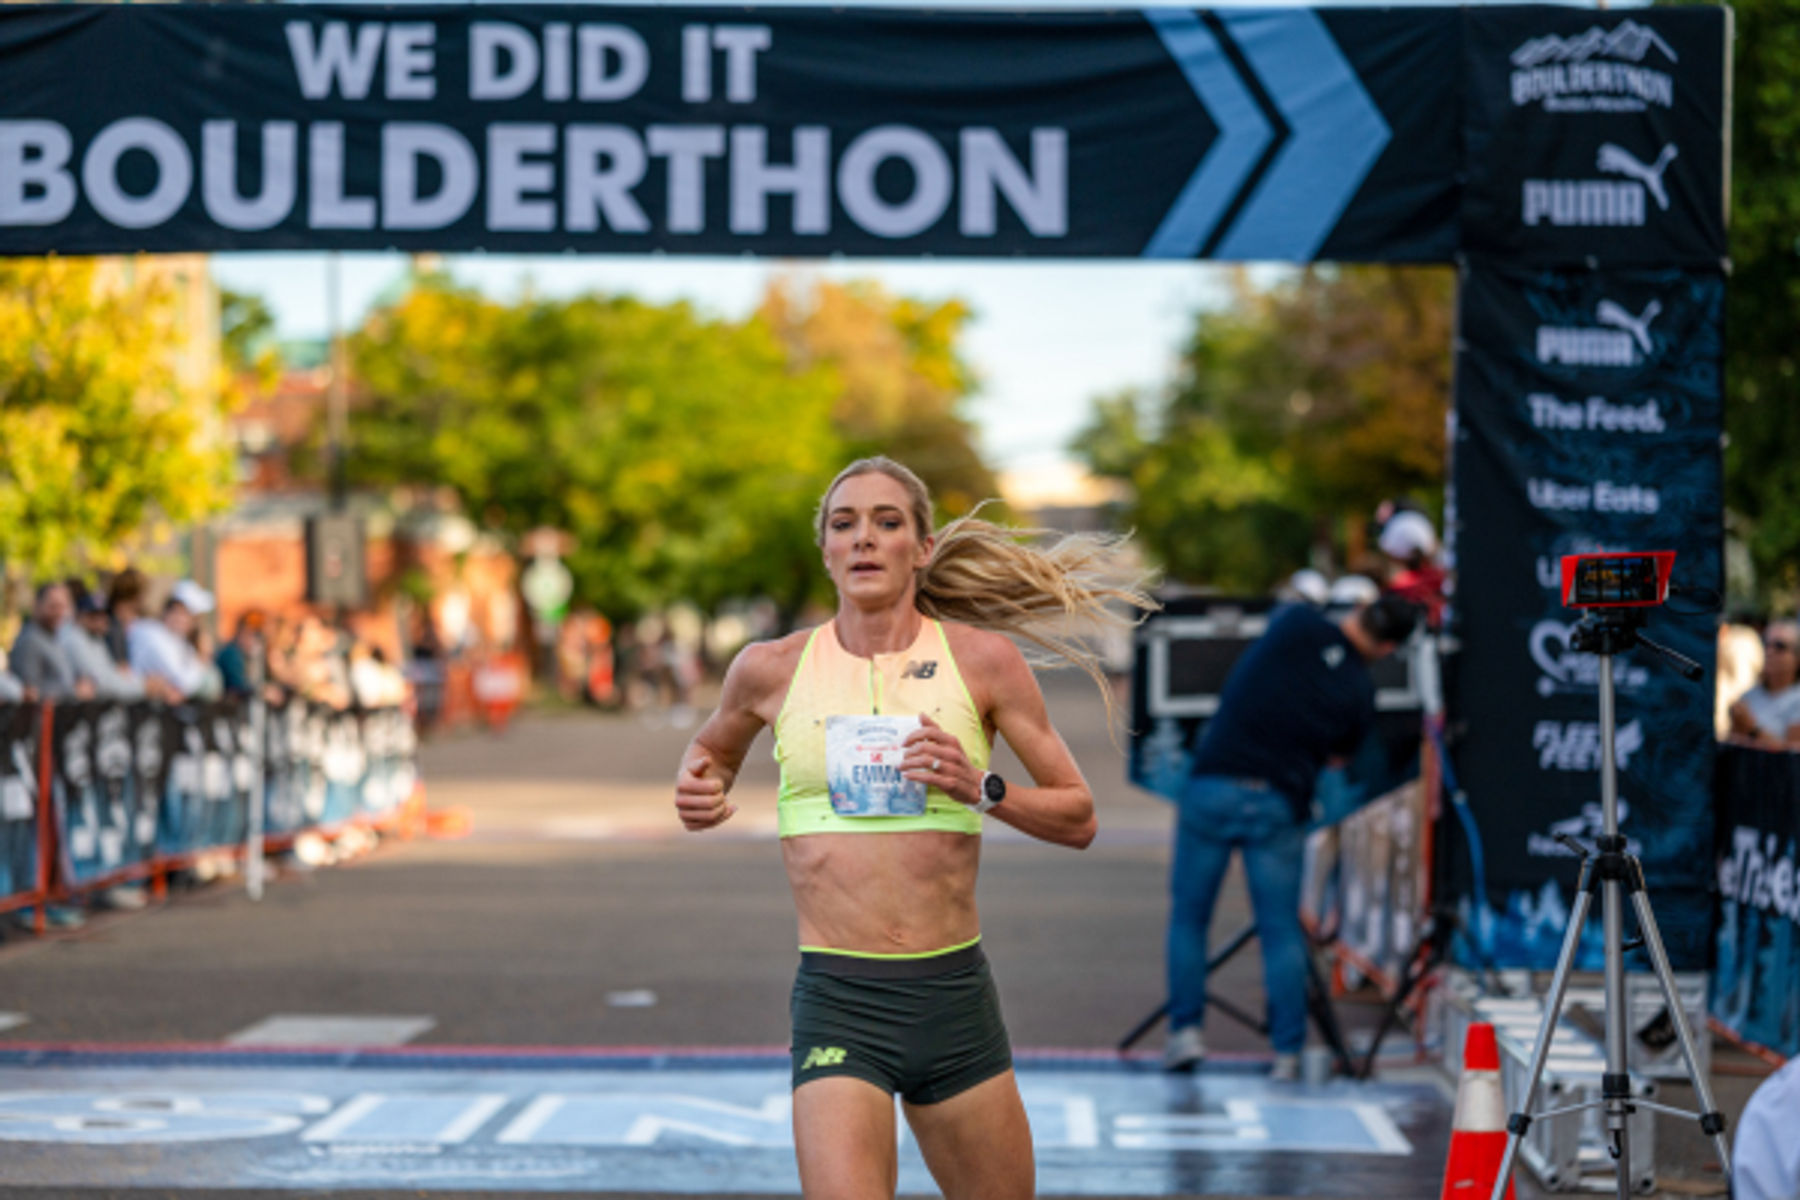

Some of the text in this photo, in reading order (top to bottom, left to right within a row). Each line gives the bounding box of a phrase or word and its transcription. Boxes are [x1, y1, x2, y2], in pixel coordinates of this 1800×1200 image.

[285, 21, 771, 101] WE DID IT
[0, 117, 1068, 237] BOULDERTHON
[1522, 179, 1645, 226] PUMA
[1536, 325, 1634, 366] PUMA
[1526, 393, 1666, 433] The Feed.
[1527, 476, 1659, 514] Uber Eats
